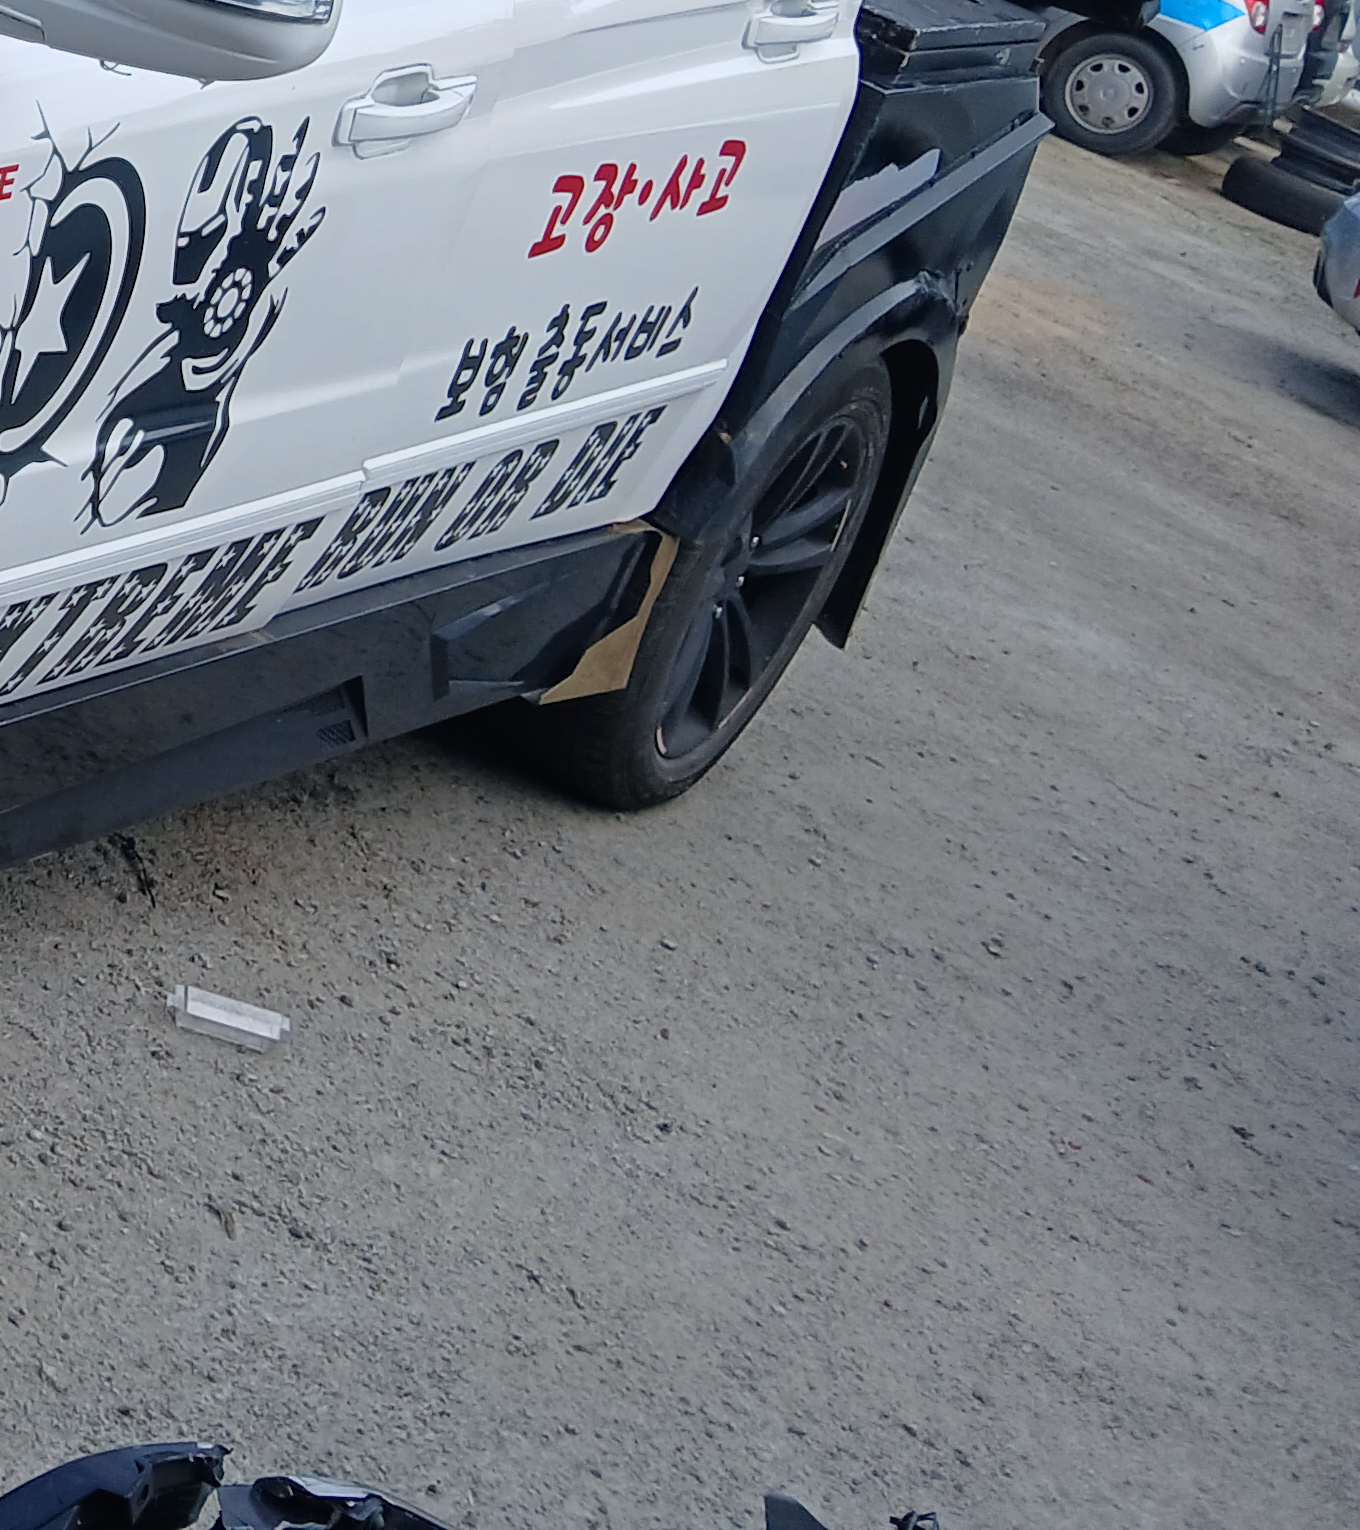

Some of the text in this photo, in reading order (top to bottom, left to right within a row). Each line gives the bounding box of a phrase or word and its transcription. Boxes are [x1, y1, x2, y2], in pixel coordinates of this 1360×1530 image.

[435, 325, 529, 422] 보험
[293, 460, 476, 595] RUN
[434, 438, 559, 553] OR
[529, 405, 668, 520] DIE
